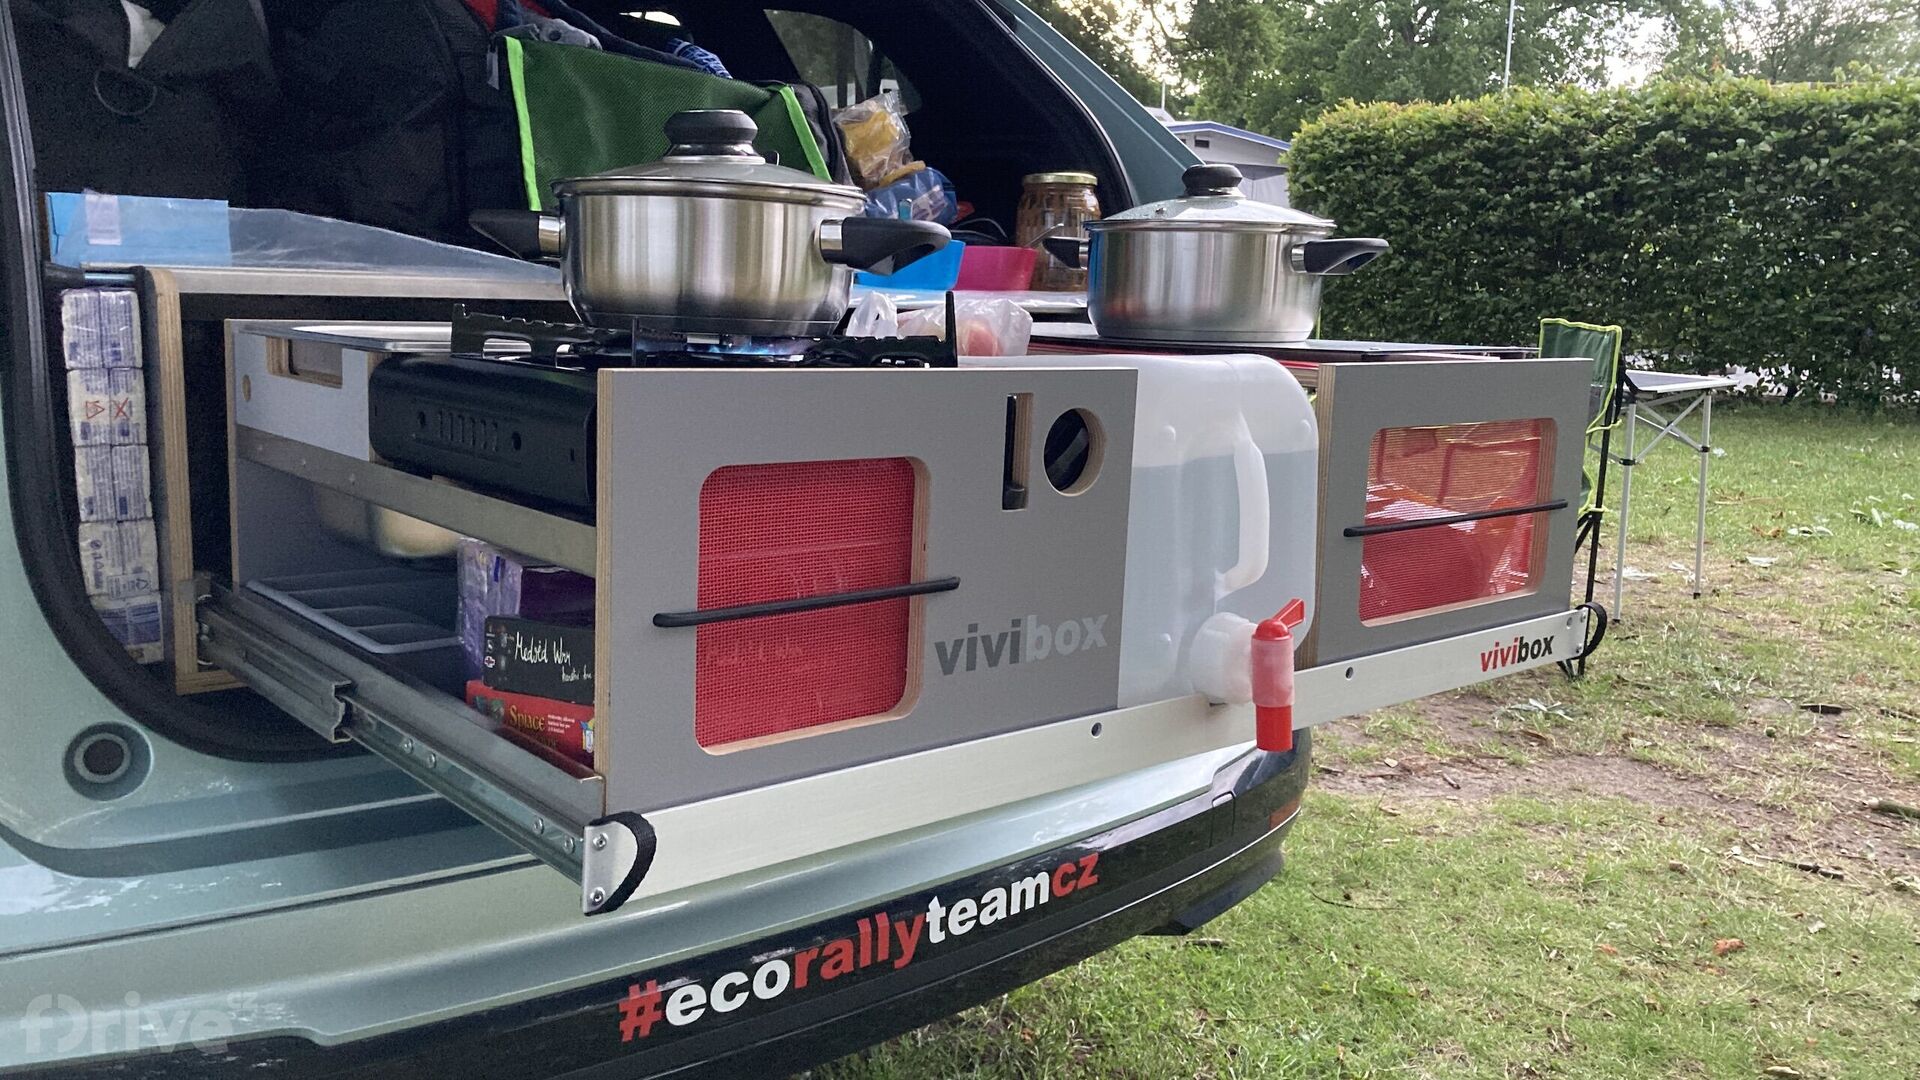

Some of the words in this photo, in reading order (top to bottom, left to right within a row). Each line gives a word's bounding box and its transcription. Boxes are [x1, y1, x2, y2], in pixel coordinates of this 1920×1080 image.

[934, 614, 1109, 676] vivibox
[1480, 635, 1554, 672] vivibox
[618, 852, 1100, 1043] #ecorallyteamcz
